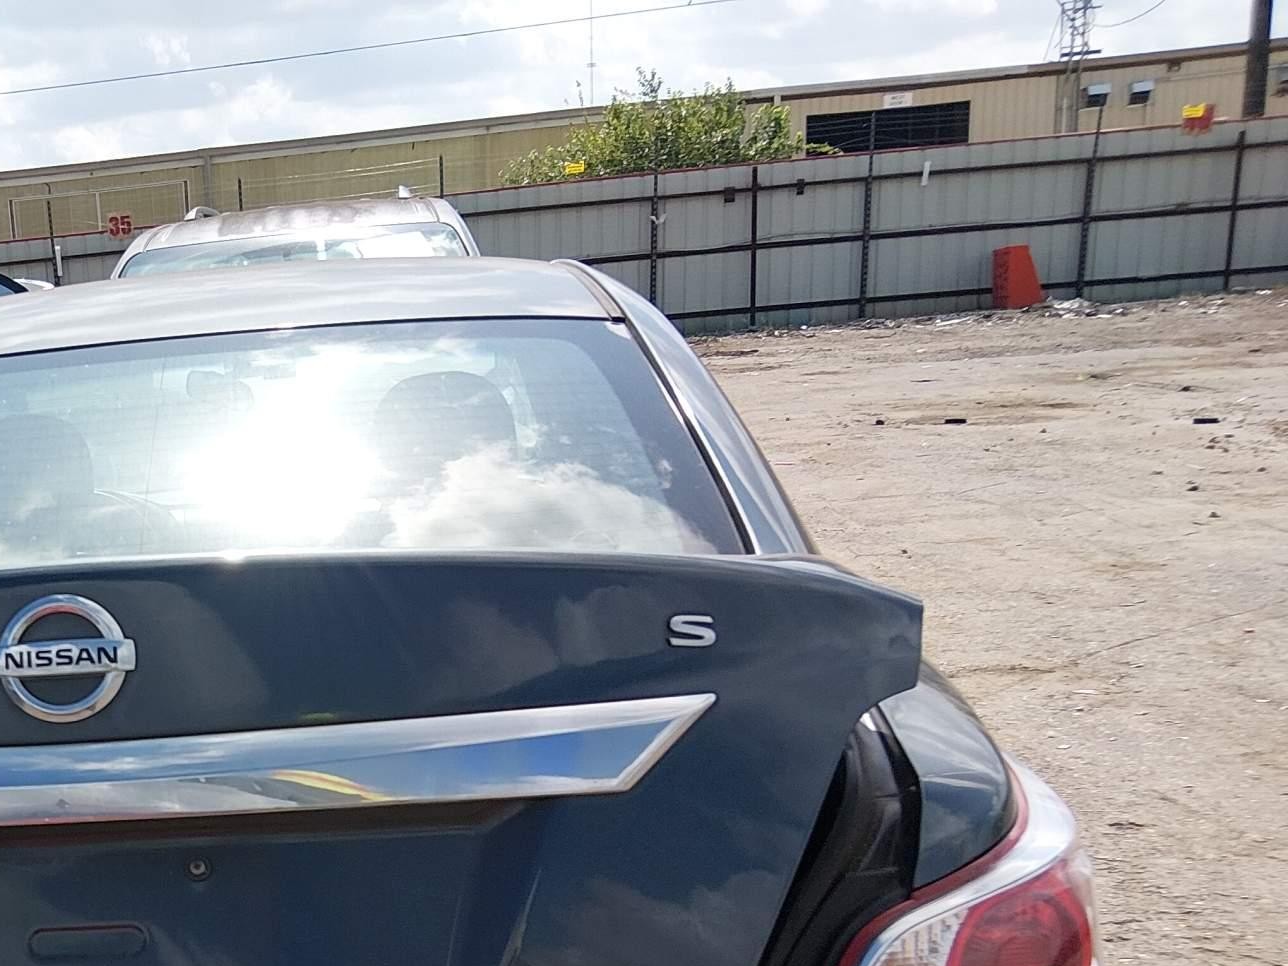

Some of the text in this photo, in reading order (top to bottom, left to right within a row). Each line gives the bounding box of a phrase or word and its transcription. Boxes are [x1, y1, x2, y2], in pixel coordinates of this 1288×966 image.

[109, 215, 132, 236] 35
[668, 614, 717, 648] S
[2, 644, 121, 672] NISSAN
